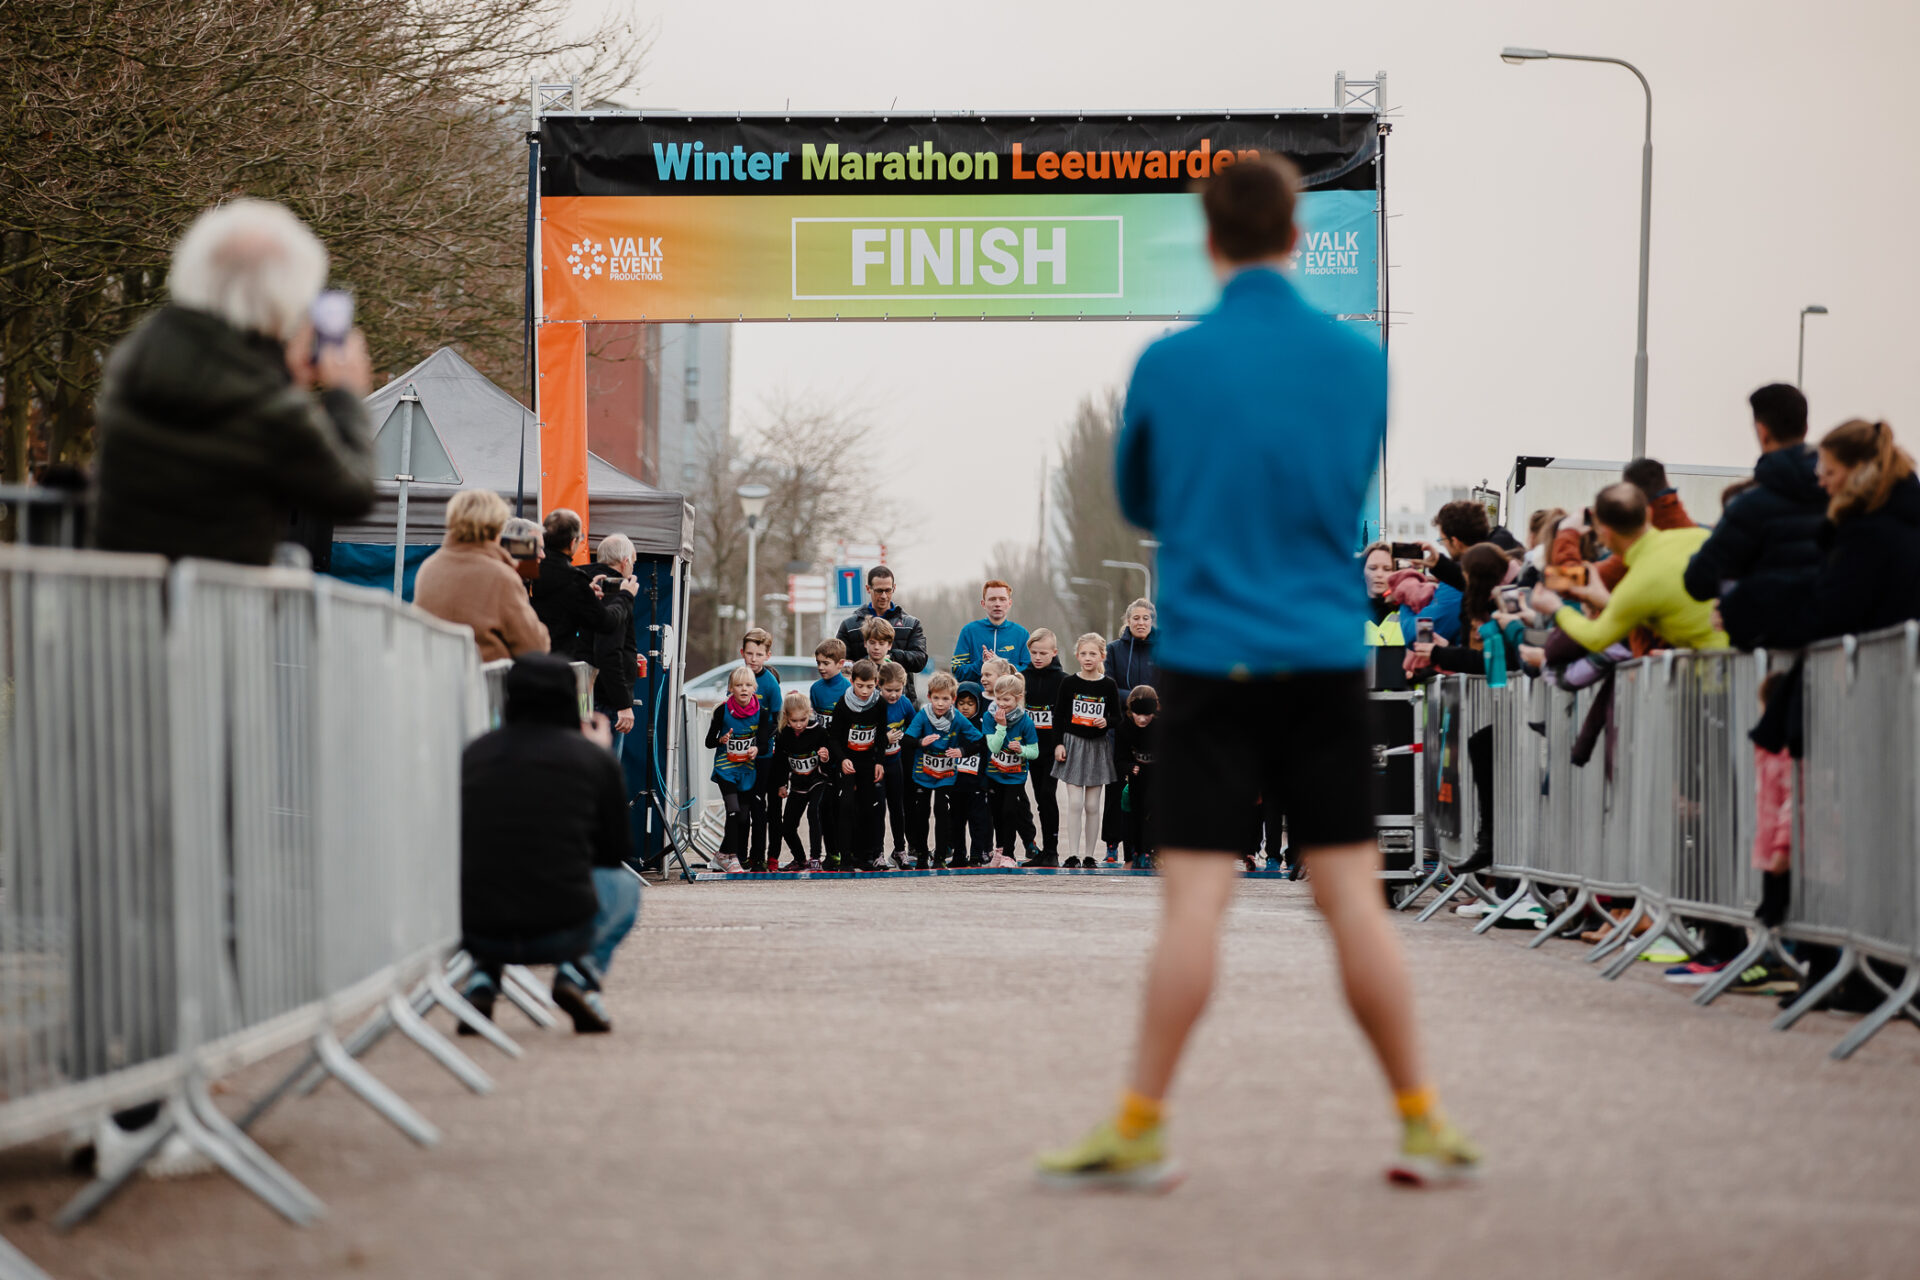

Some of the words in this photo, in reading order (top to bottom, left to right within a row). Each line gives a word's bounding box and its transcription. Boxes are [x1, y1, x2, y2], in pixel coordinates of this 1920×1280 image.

[653, 141, 789, 181] Winter
[802, 140, 999, 181] Marathon
[609, 237, 663, 257] VALK
[1305, 231, 1359, 251] VALK
[851, 227, 1067, 286] FINISH
[1306, 251, 1359, 267] EVENT
[610, 257, 663, 273] EVENT
[1305, 267, 1359, 275] PRODUCTIONS
[610, 272, 663, 280] PRODUCTIONS
[1074, 702, 1102, 715] 5030
[1025, 710, 1050, 723] 012
[851, 730, 875, 741] 501
[791, 758, 817, 770] 5019
[925, 756, 953, 768] 5014
